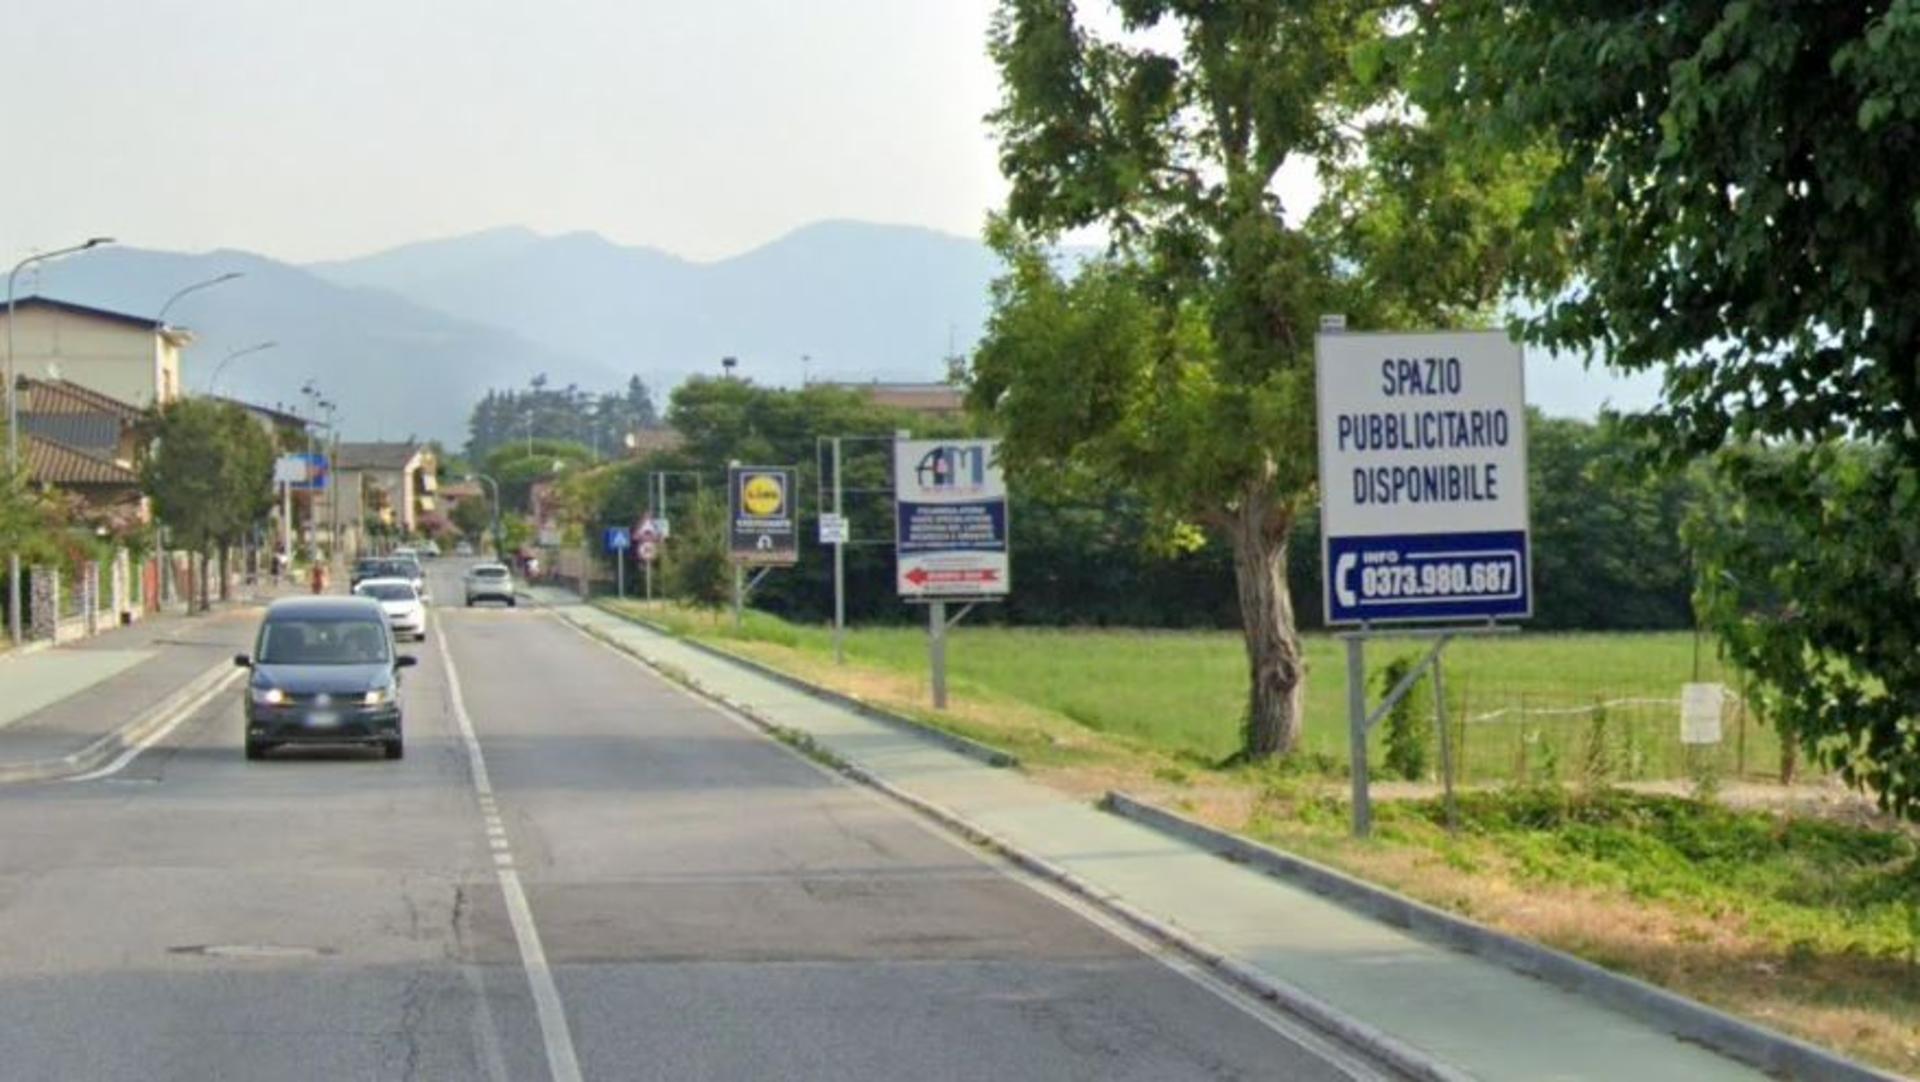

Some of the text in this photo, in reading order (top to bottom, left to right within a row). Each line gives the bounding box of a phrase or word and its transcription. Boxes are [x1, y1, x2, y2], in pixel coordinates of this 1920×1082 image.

[1382, 357, 1462, 397] SPAZIO
[1338, 409, 1508, 451] PUBBLICITARIO
[1353, 463, 1499, 505] DISPONIBILE
[1363, 550, 1400, 564] INFO
[1361, 561, 1512, 597] 0373.980.687
